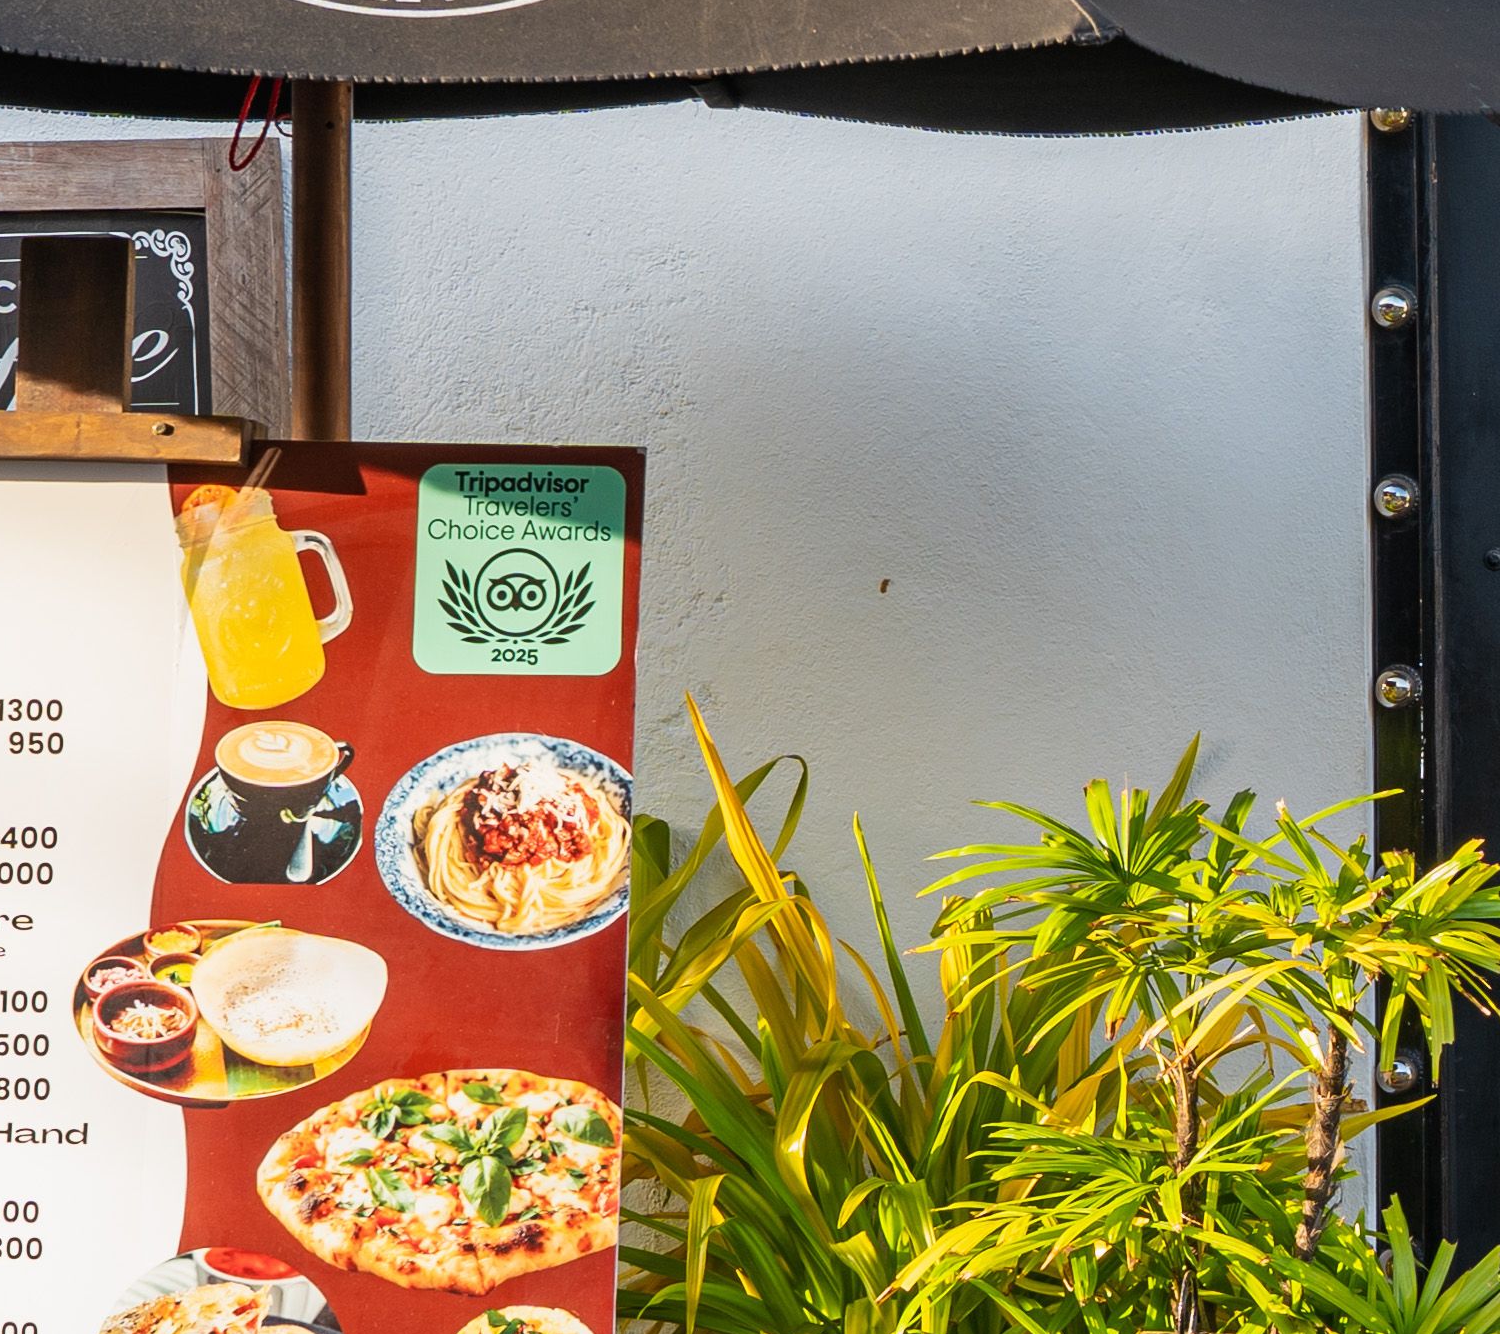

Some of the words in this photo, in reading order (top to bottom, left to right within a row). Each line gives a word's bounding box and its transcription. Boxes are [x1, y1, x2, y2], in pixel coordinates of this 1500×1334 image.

[455, 471, 590, 497] Tripadvisor
[428, 519, 515, 540] Choice
[521, 520, 611, 541] Awards
[491, 648, 538, 665] 2025
